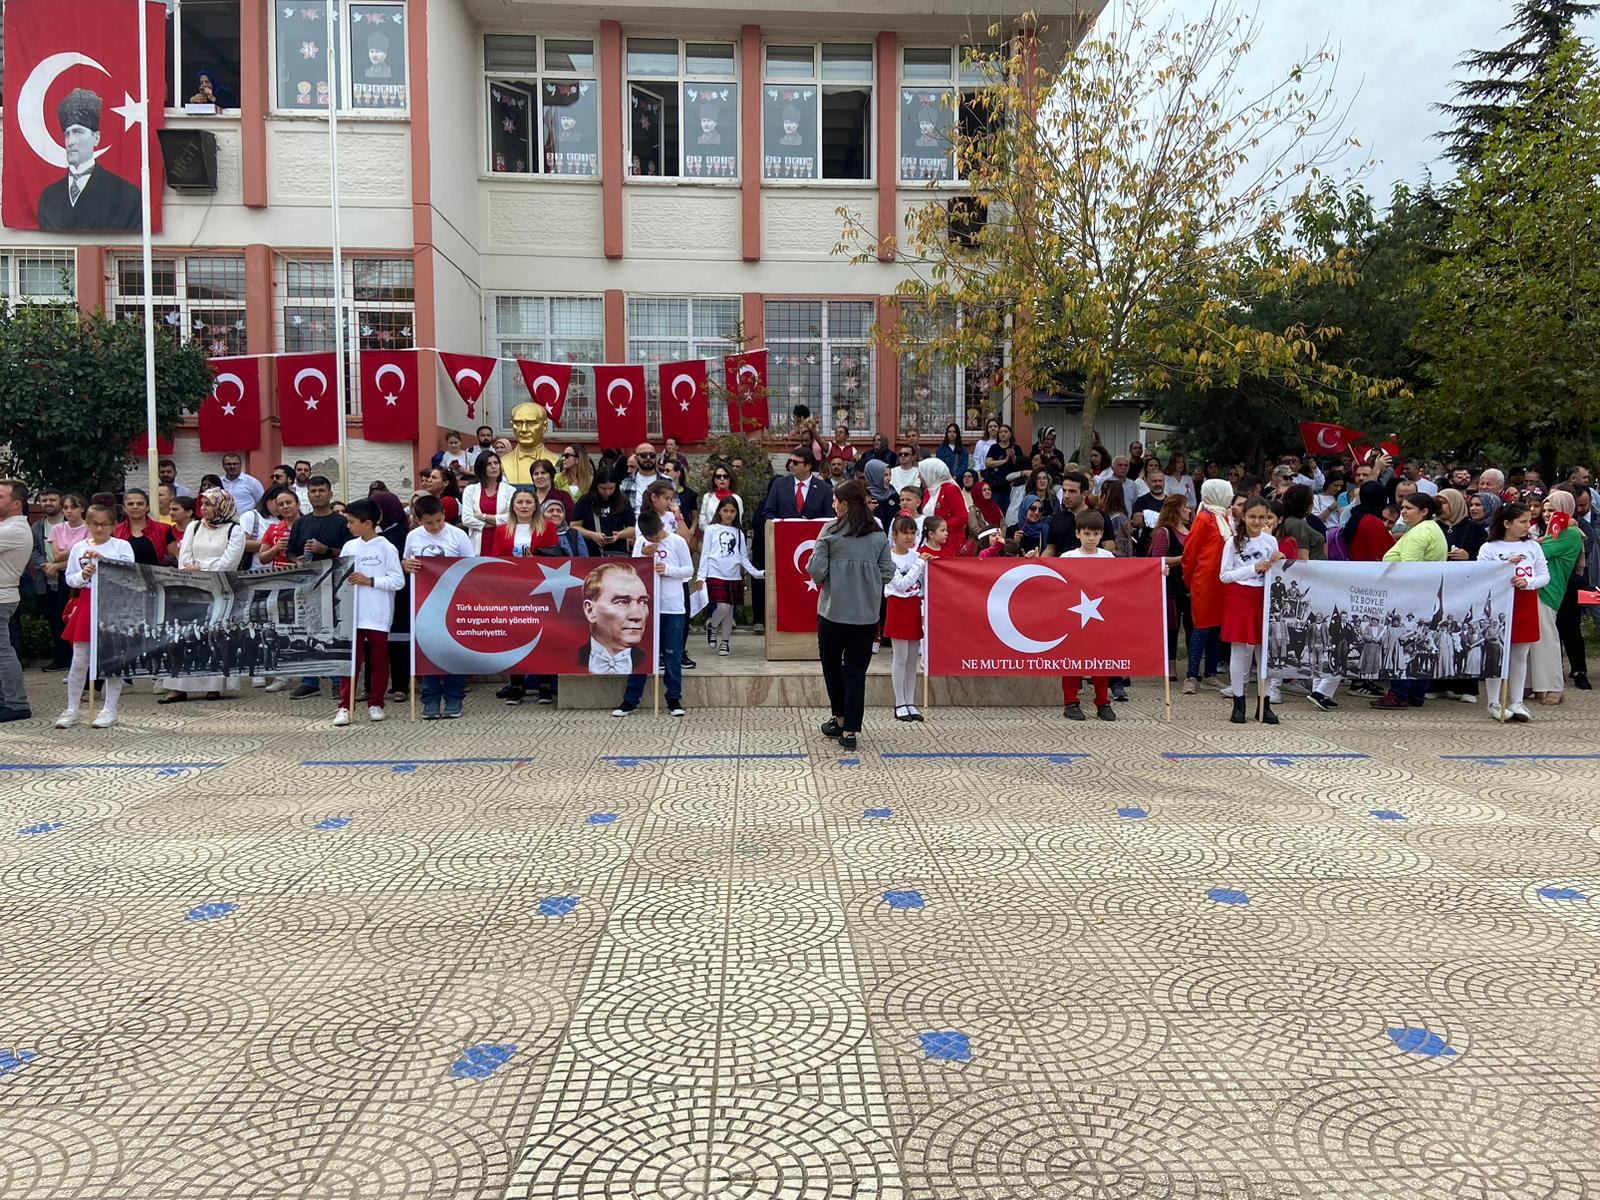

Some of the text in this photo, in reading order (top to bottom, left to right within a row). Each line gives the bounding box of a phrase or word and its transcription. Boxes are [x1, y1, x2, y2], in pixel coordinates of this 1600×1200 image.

[456, 604, 550, 614] Türk ulusunun yaratılışına
[467, 617, 490, 626] uygun
[491, 616, 508, 624] olan
[509, 616, 540, 627] yönetim
[456, 628, 508, 639] cumhuriyettir.
[962, 659, 978, 670] NE
[980, 659, 1025, 670] MUTLU
[1084, 658, 1131, 670] DİYENE!
